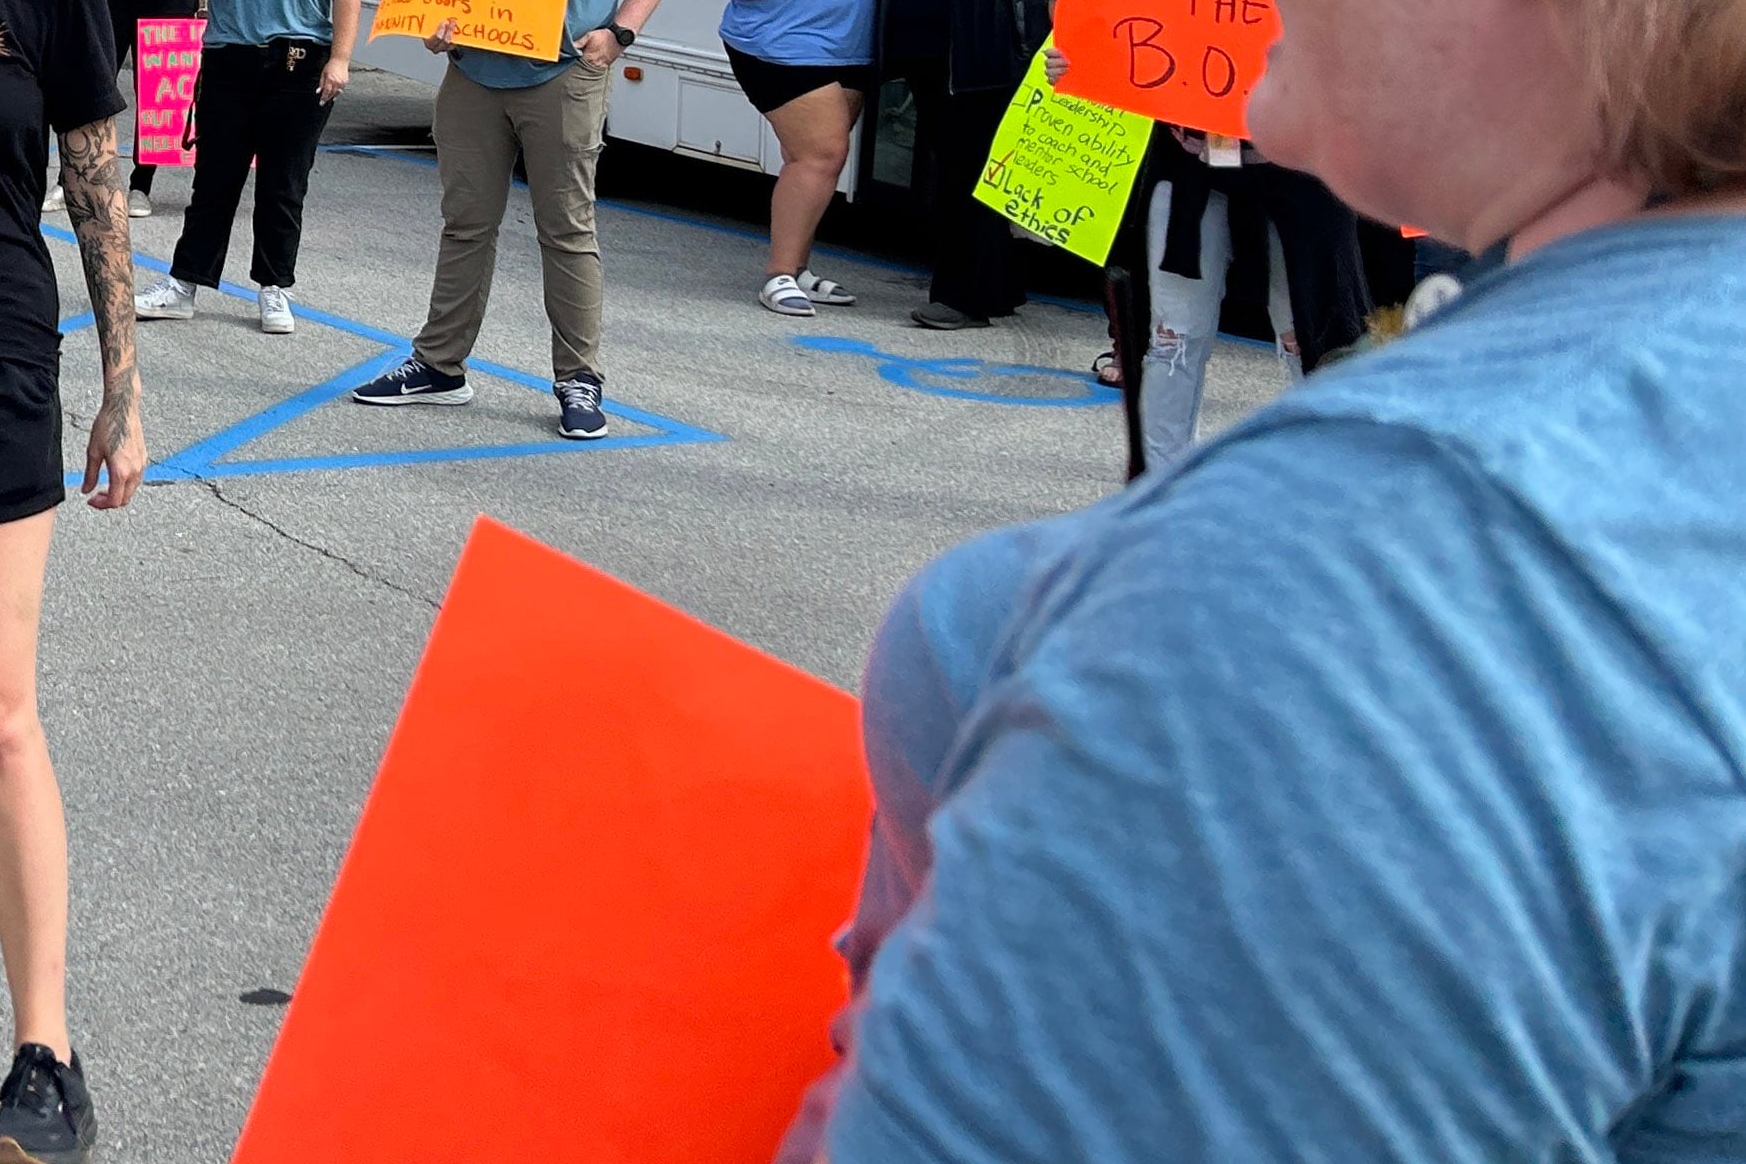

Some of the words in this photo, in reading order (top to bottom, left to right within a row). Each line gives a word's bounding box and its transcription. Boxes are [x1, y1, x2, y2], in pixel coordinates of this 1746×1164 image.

[142, 25, 178, 45] THE
[490, 1, 513, 22] in
[1023, 119, 1035, 135] to
[1038, 134, 1077, 157] coach
[1081, 153, 1113, 177] and
[1025, 88, 1073, 136] Proven
[1078, 134, 1136, 167] ability
[1013, 150, 1060, 186] leaders
[1017, 138, 1064, 165] mentor
[1066, 164, 1119, 195] school
[1004, 170, 1045, 210] Lack
[1054, 205, 1095, 226] of
[1005, 200, 1071, 245] ethics
